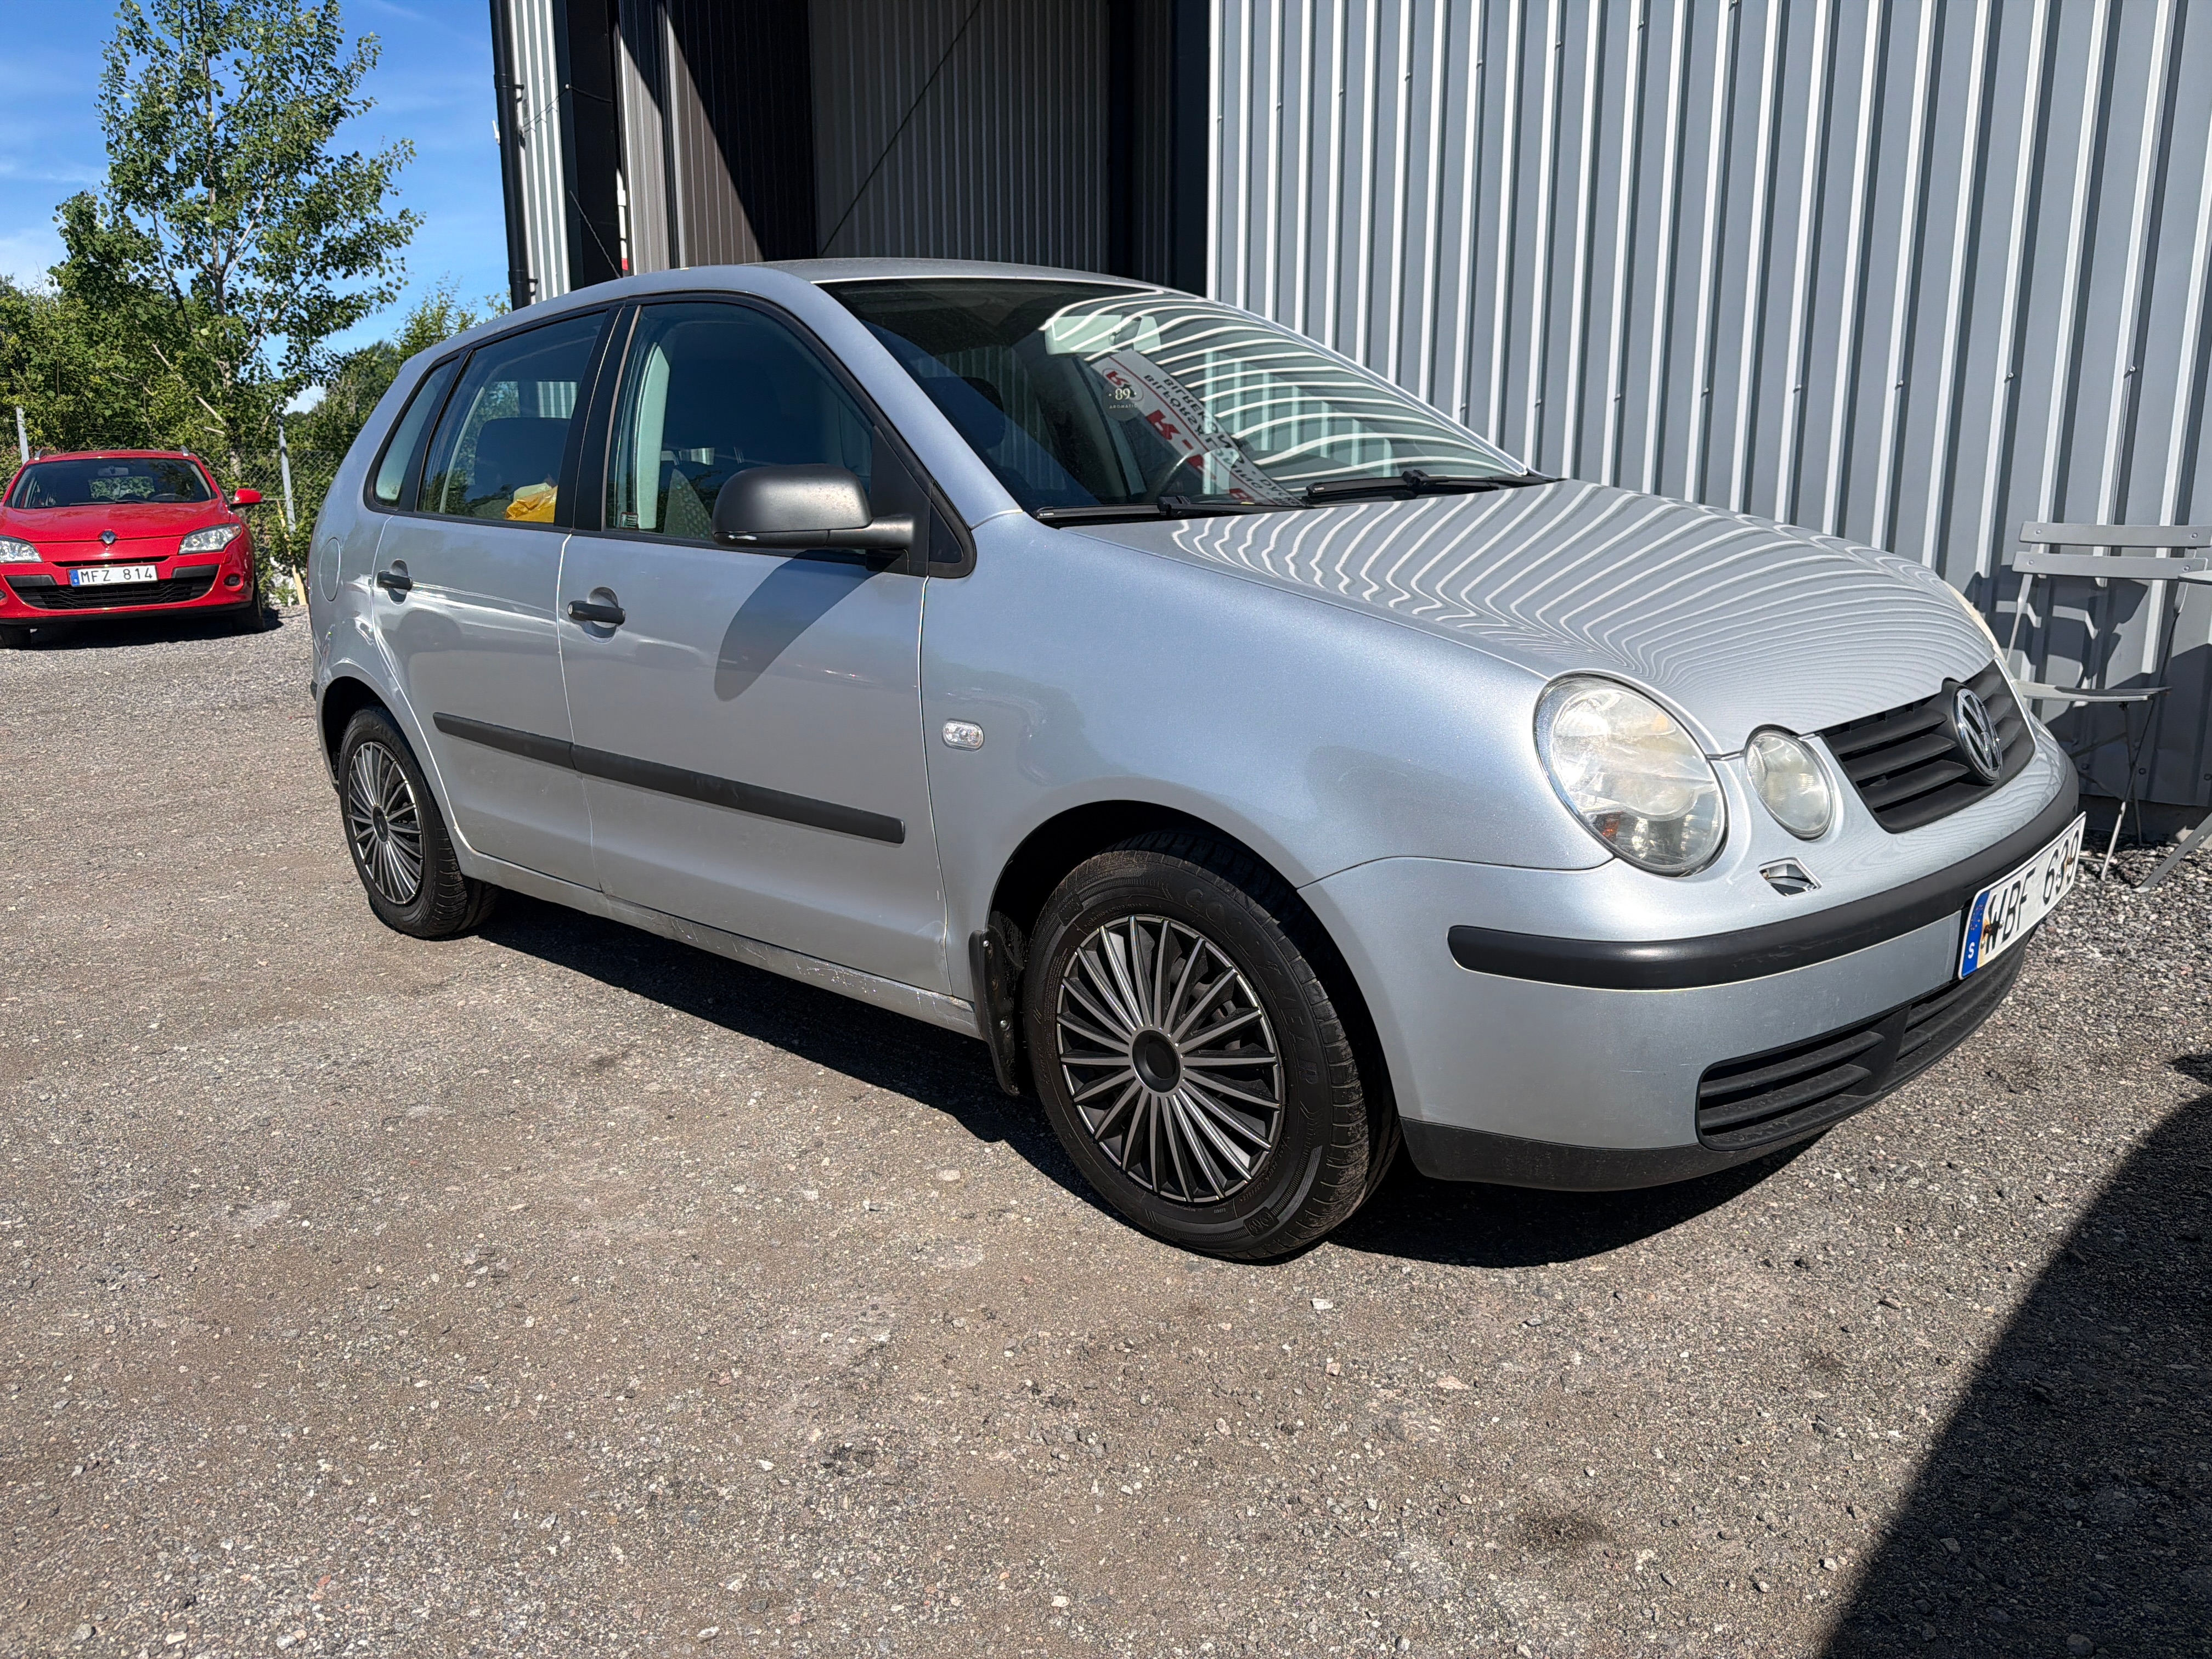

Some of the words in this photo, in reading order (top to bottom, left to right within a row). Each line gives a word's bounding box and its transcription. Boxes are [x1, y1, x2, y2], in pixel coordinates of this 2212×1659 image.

[1115, 387, 1131, 400] 89
[81, 569, 111, 583] MFZ
[122, 567, 153, 580] 814
[1967, 941, 1976, 959] S
[1985, 864, 2036, 955] WBF
[2042, 827, 2080, 906] 639
